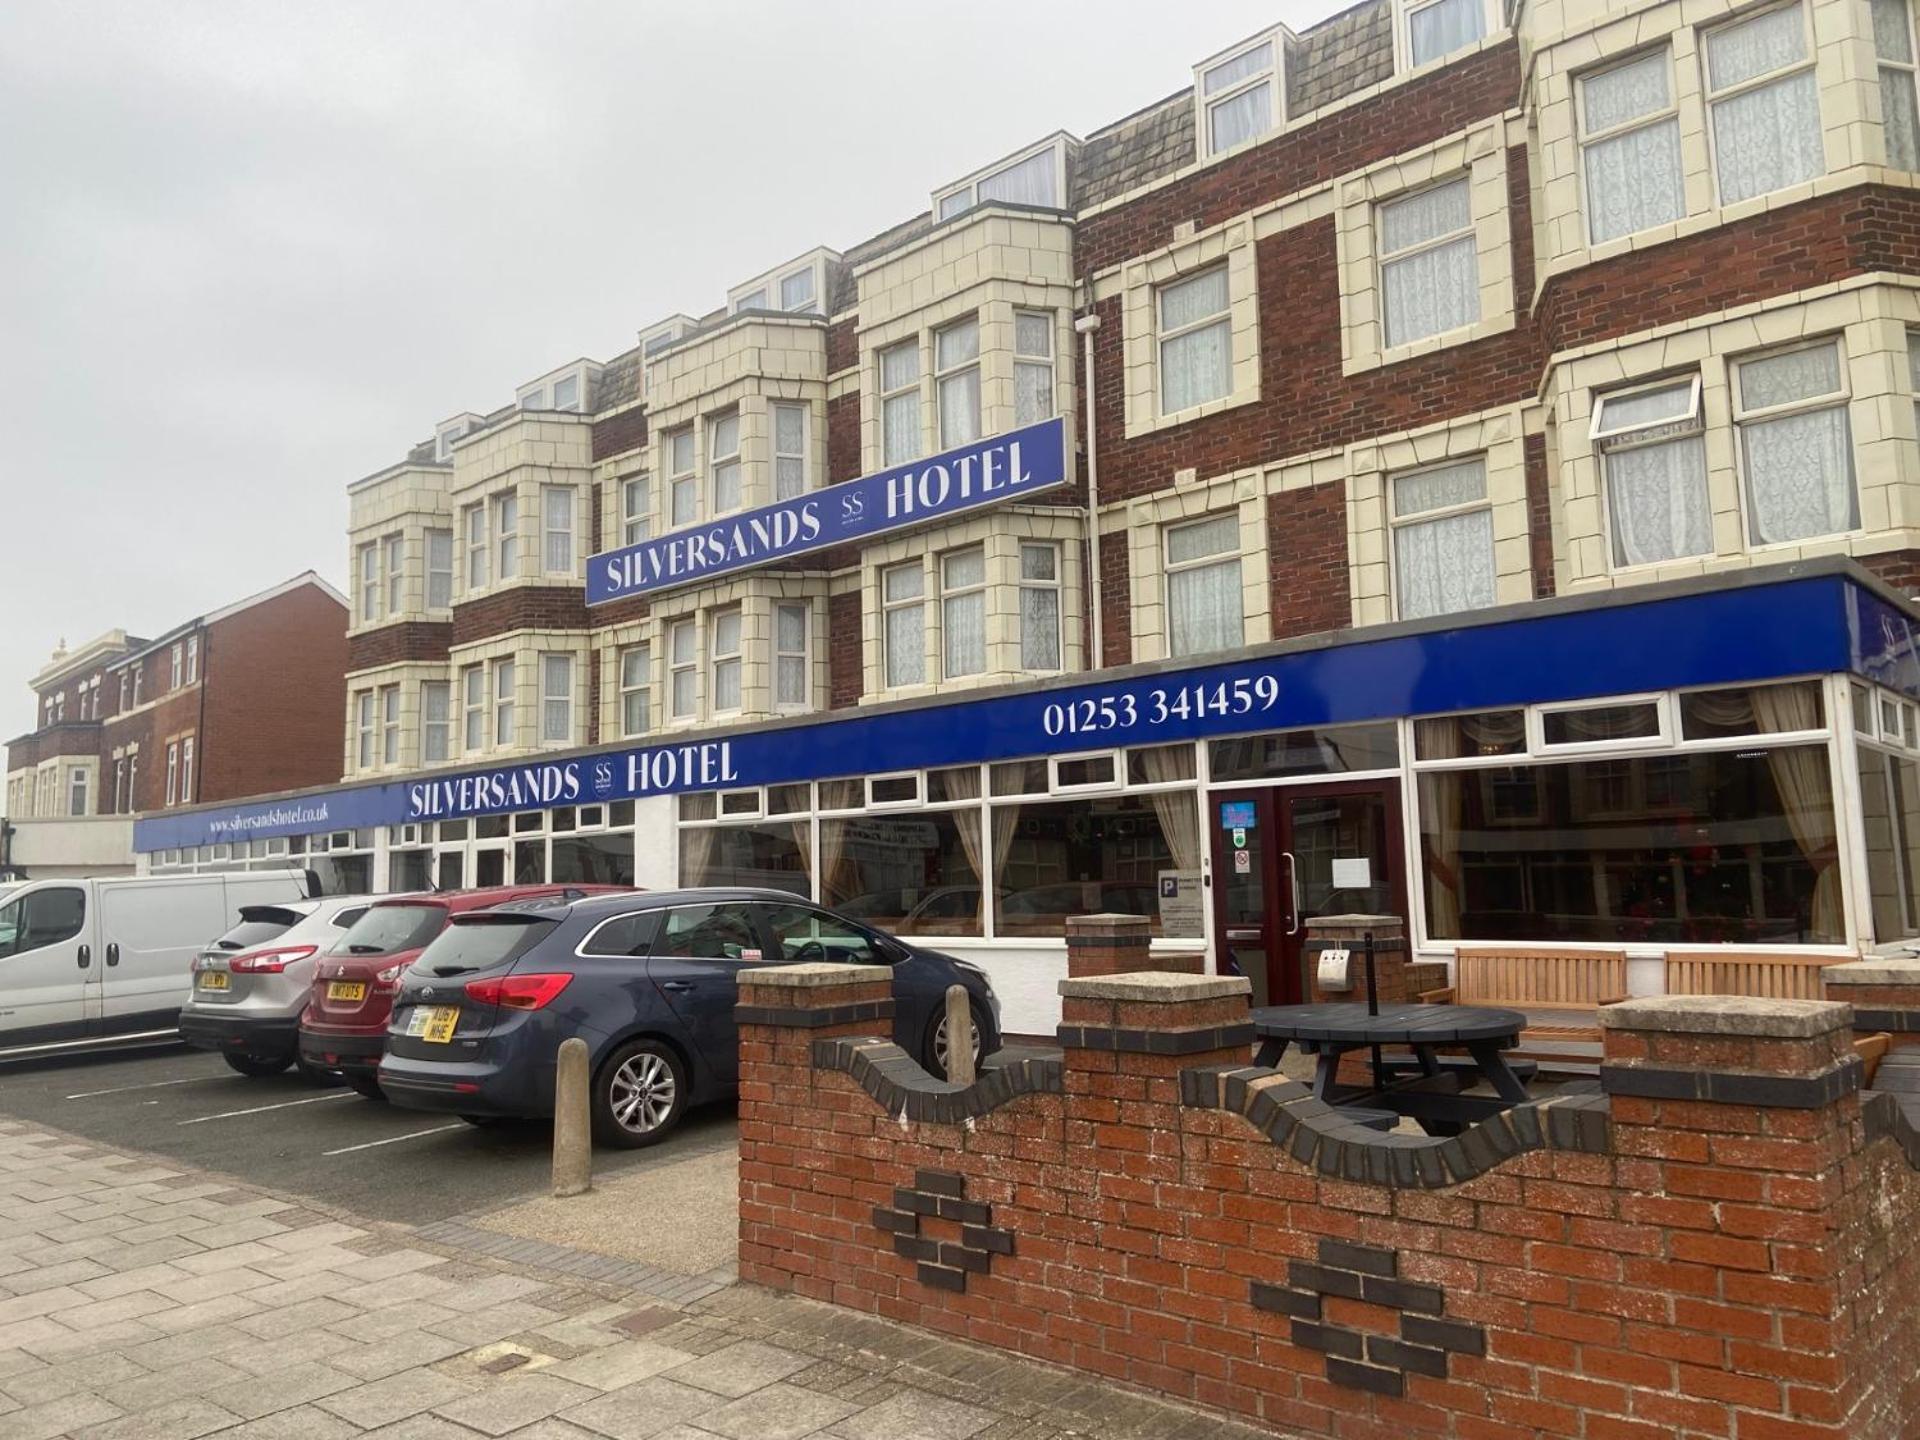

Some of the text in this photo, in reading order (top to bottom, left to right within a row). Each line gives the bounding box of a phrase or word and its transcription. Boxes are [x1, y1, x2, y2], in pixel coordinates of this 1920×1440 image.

[606, 501, 820, 592] SILVERSANDS
[885, 439, 1031, 519] HOTEL
[1042, 674, 1280, 736] 01253 341459
[409, 762, 581, 818] SILVERSANDS
[626, 741, 739, 793] HOTEL
[209, 802, 329, 832] www.silversandshotel.co.uk
